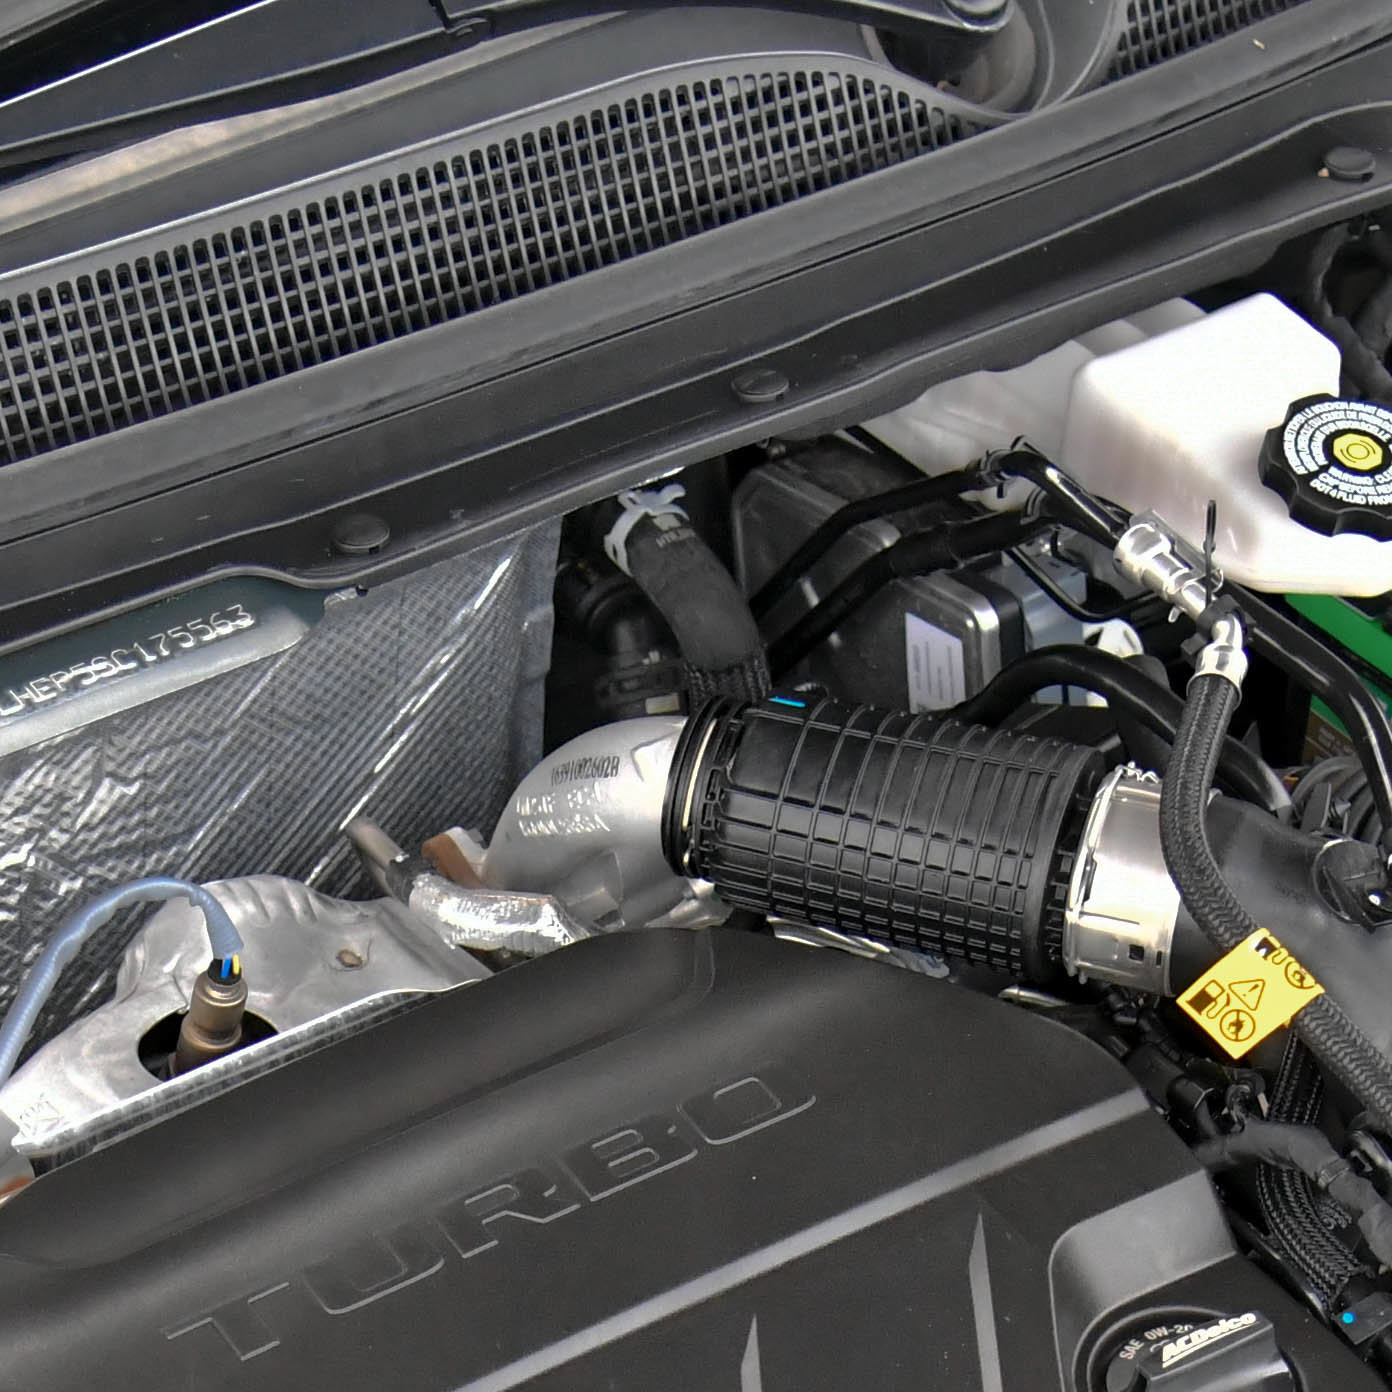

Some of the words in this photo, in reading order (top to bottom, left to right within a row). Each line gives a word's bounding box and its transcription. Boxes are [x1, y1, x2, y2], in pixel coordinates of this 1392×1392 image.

[164, 1076, 817, 1361] TURBO
[1119, 1338, 1144, 1360] SAE
[1162, 1312, 1257, 1369] ACDelco
